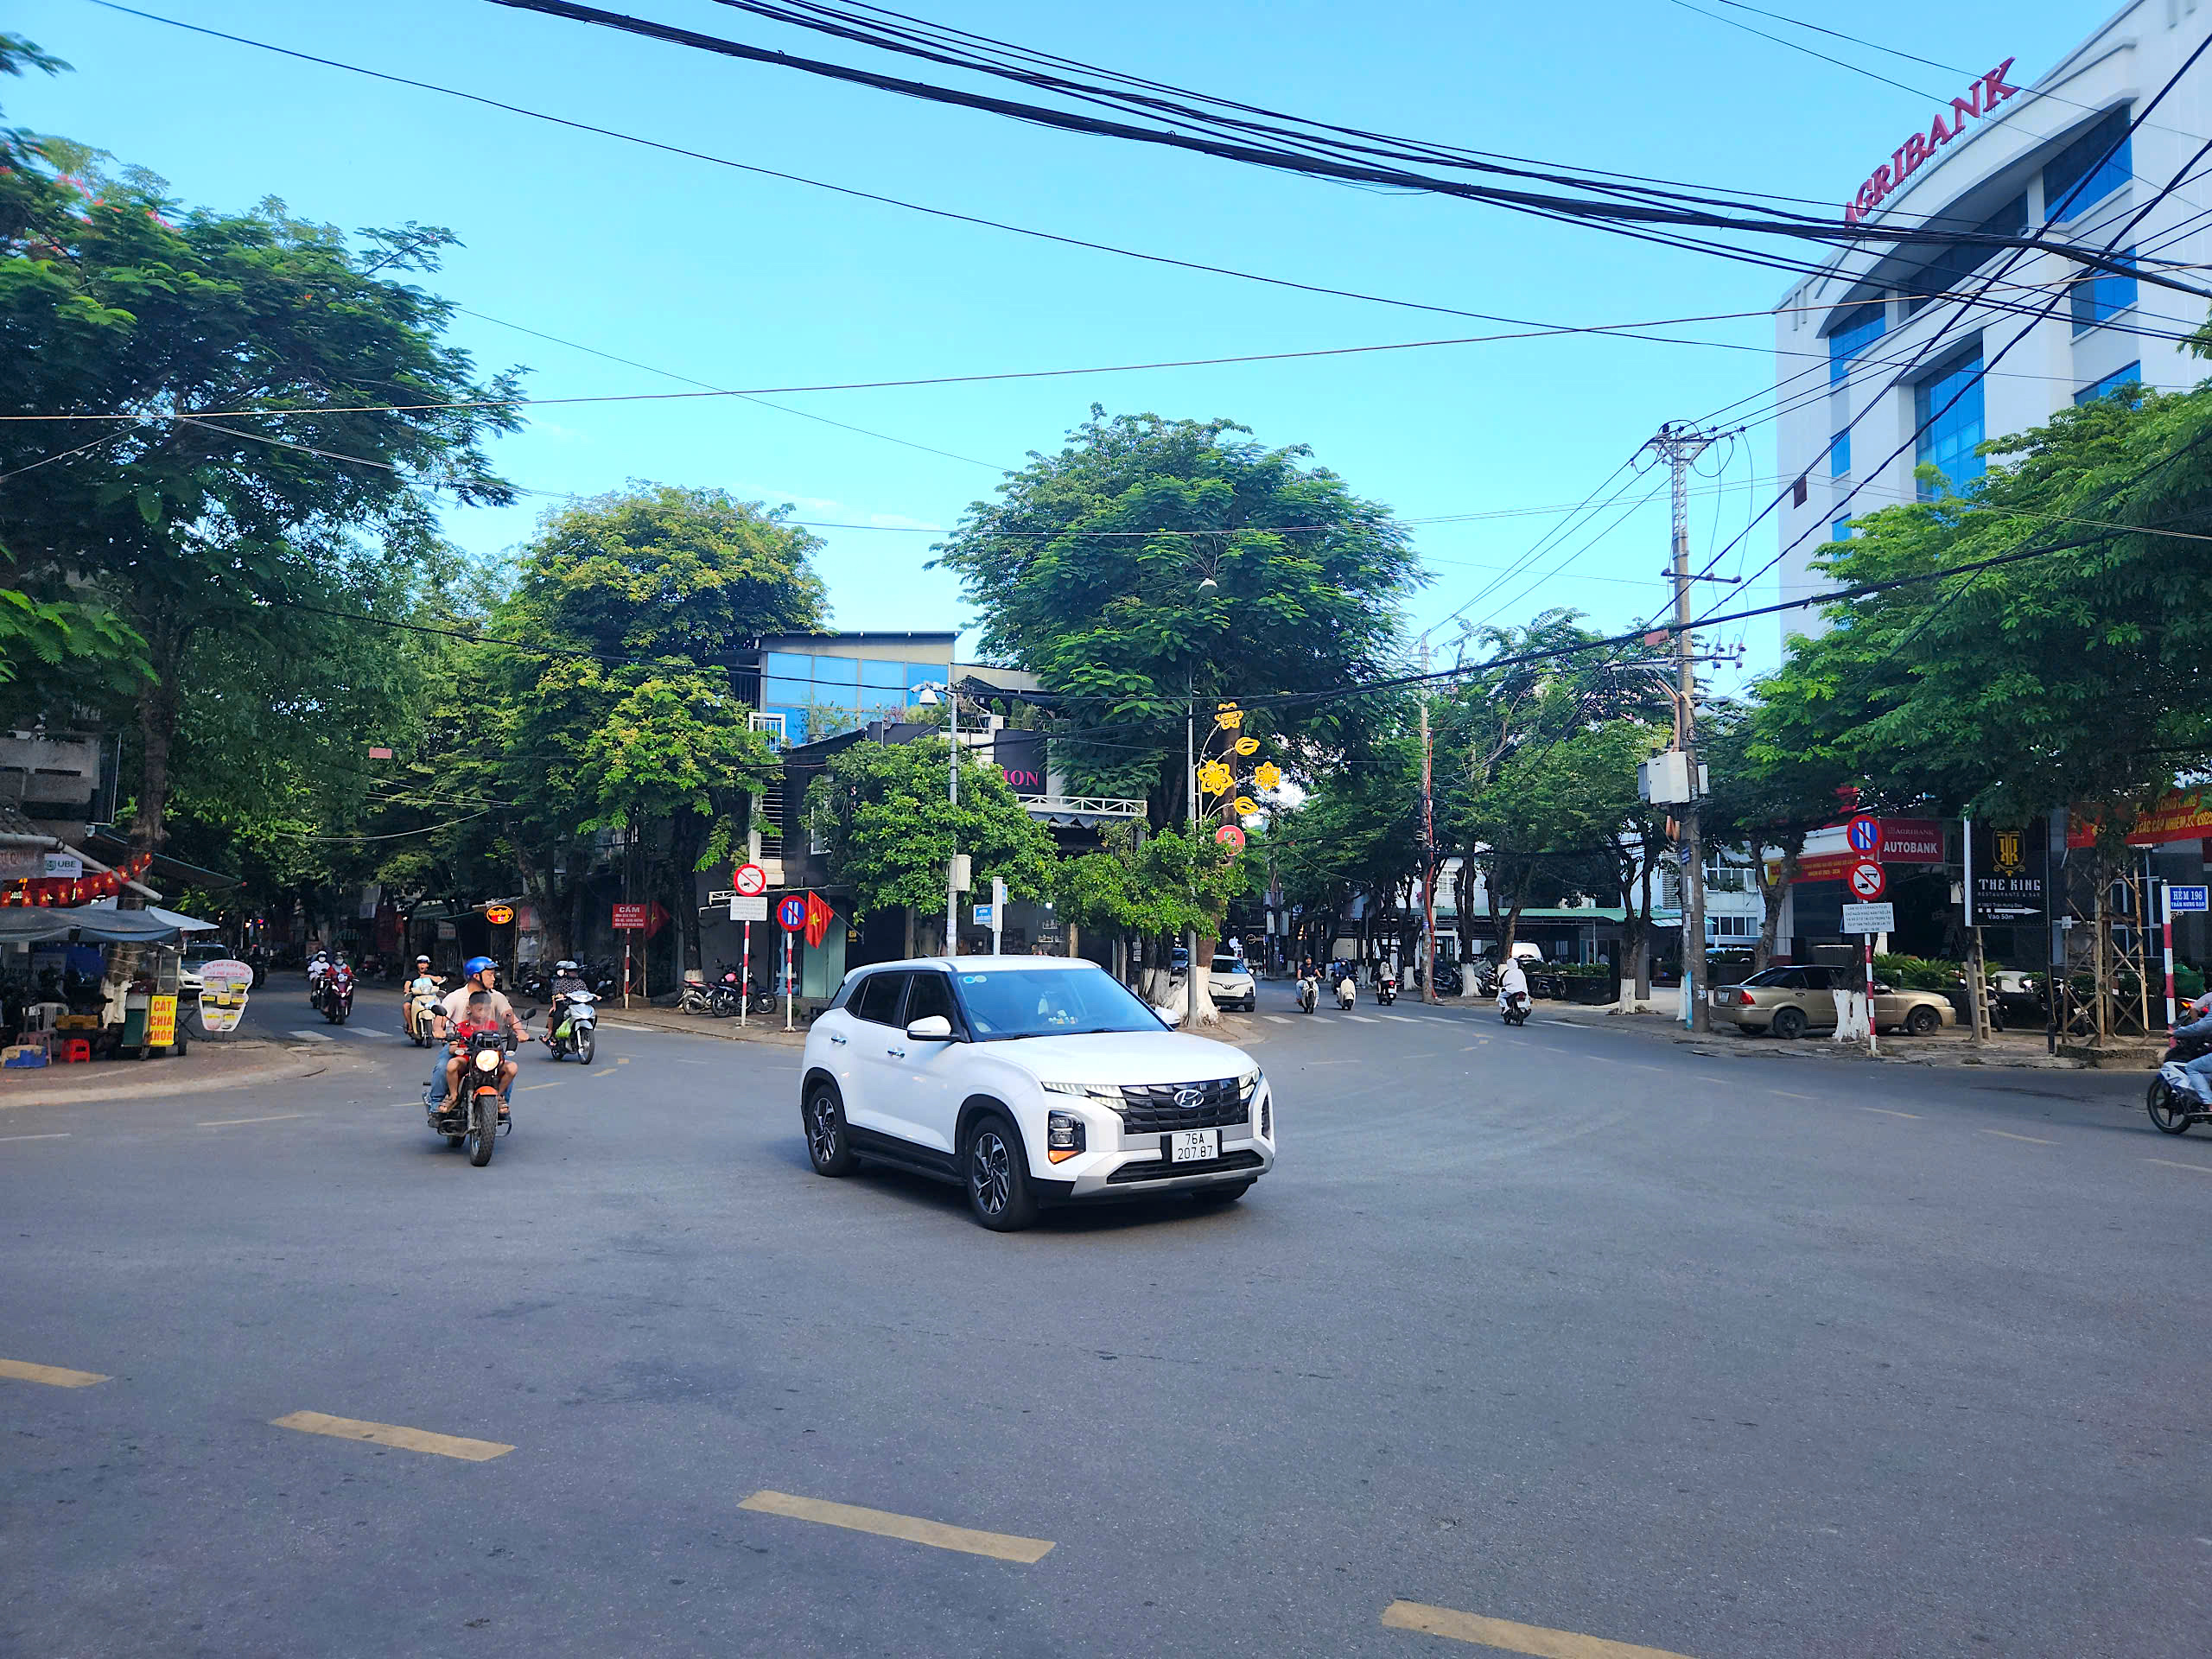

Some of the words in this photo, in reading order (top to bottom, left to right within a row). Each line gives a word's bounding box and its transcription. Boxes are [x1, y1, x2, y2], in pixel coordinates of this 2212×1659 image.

[1844, 56, 2020, 229] AGRIBANK
[1884, 841, 1937, 854] AUTOBANK
[57, 860, 77, 868] UBE
[1978, 878, 2005, 891] THE
[2011, 879, 2041, 891] KING
[2191, 891, 2202, 900] 196
[1185, 1133, 1205, 1146] 76A
[1178, 1146, 1212, 1160] 207.87
